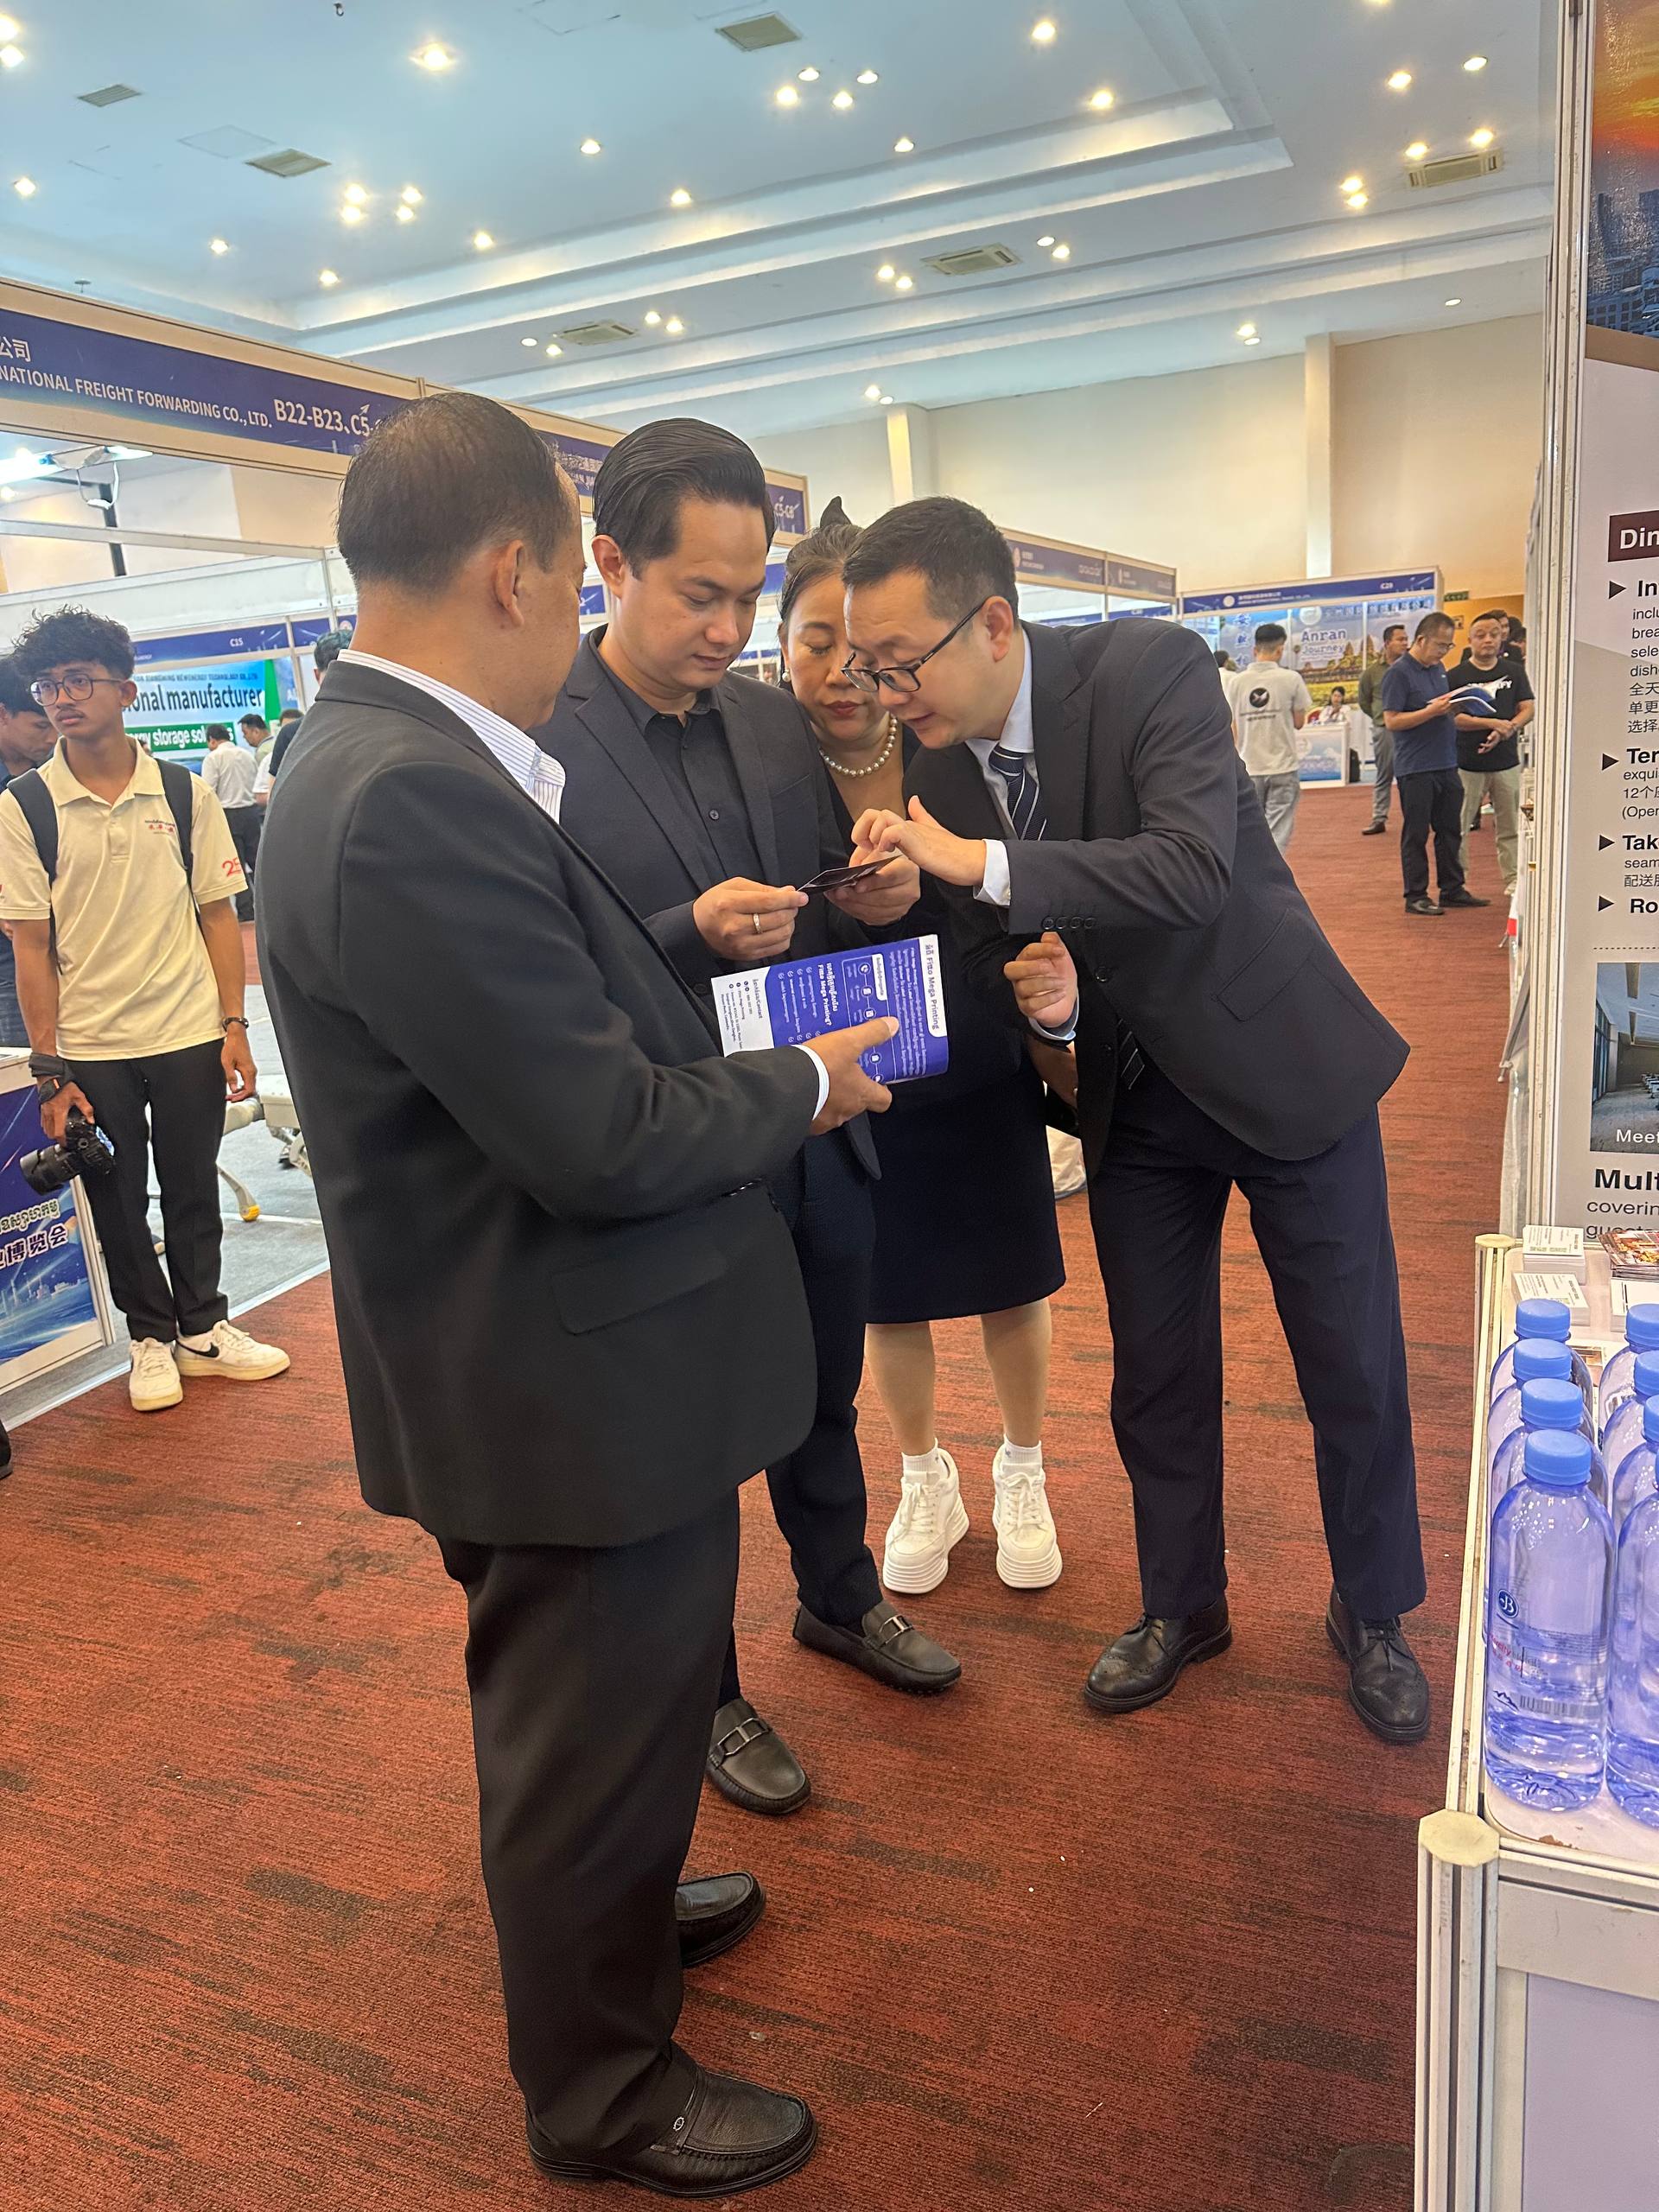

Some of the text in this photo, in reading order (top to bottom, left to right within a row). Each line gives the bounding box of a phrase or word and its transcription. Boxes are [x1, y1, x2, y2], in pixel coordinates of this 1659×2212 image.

[74, 378, 134, 404] FREIGHT
[137, 390, 221, 420] FORWARDING
[1638, 580, 1659, 597] In
[1300, 629, 1347, 642] Anran
[1630, 664, 1659, 677] dish
[167, 682, 263, 711] manufacturer
[1630, 683, 1659, 696] 全天
[1629, 701, 1659, 715] 单更
[1628, 719, 1659, 734] 选择
[152, 728, 190, 749] storage
[1624, 767, 1659, 782] exqui
[1622, 834, 1659, 850] Tak
[818, 979, 828, 997] Mega
[926, 976, 937, 998] Mega
[821, 997, 831, 1027] Printing?
[928, 999, 940, 1030] Printing
